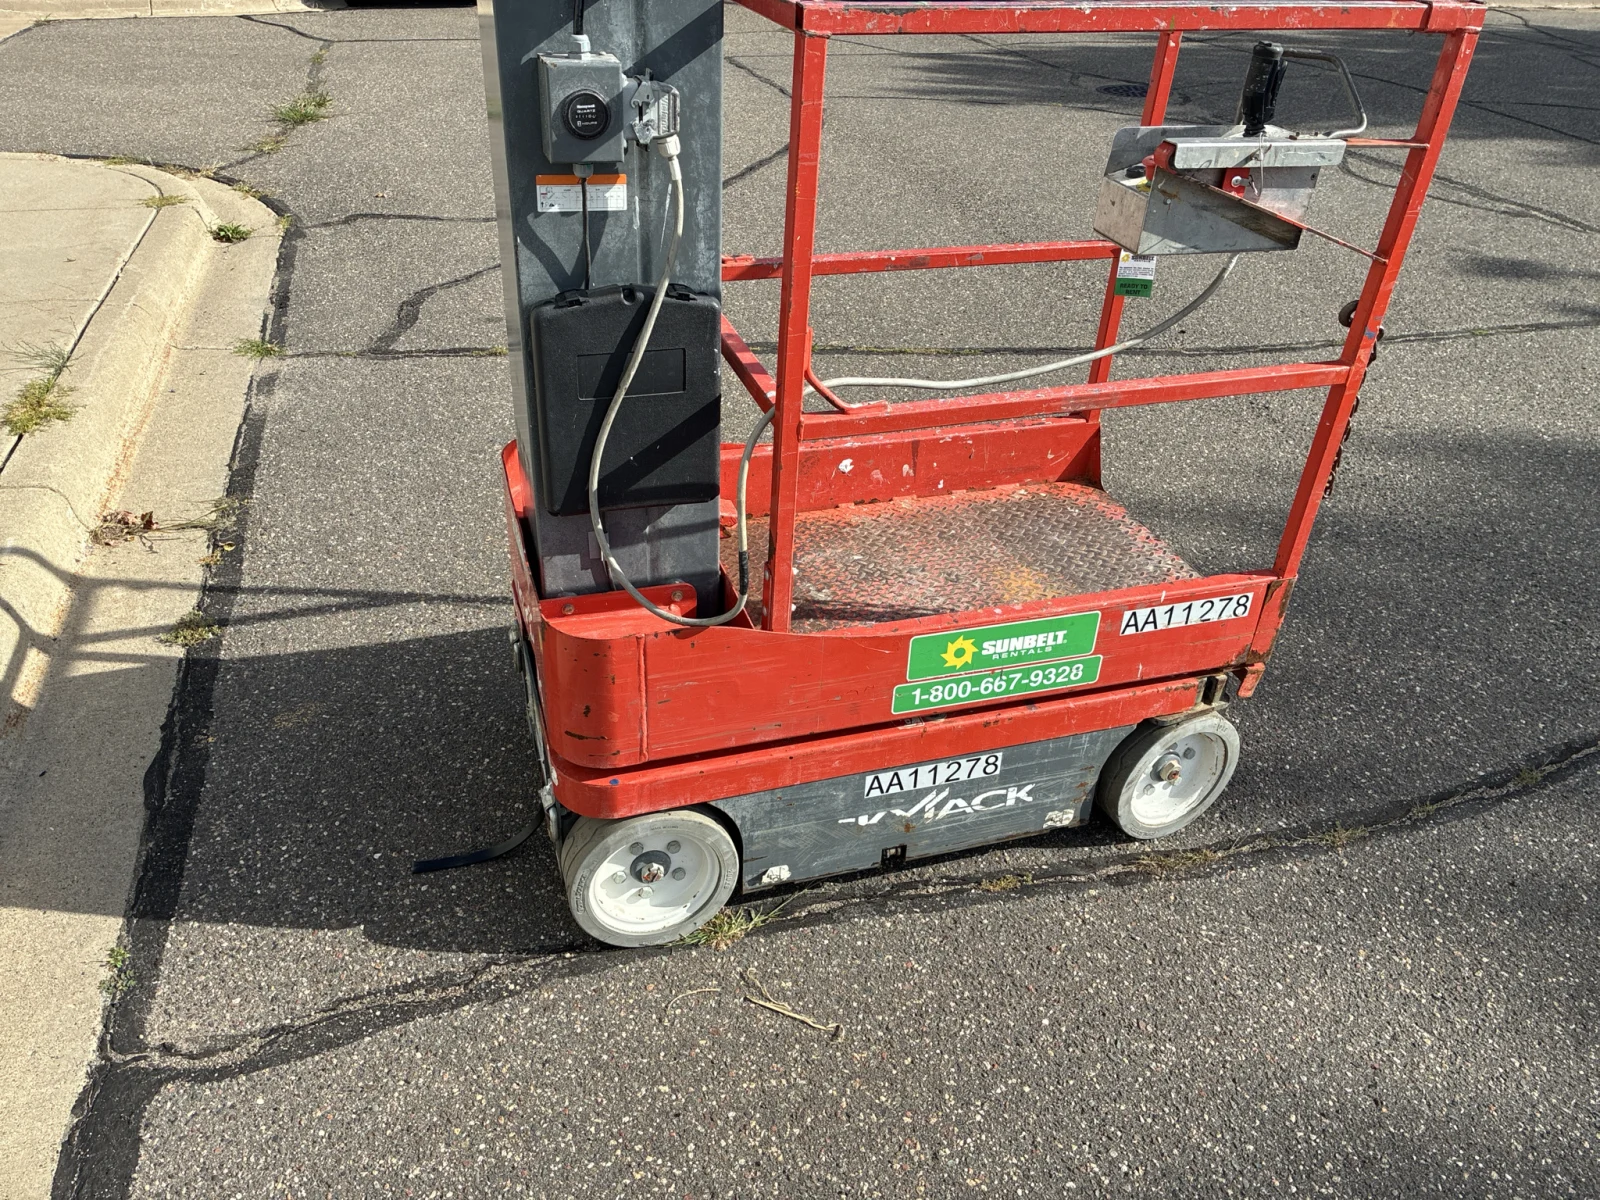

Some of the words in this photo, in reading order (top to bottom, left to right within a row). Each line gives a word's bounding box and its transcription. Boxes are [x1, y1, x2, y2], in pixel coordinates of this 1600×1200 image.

[1121, 594, 1250, 634] AA11278
[981, 630, 1067, 655] SUNBELT
[992, 646, 1052, 660] RENTALS
[911, 663, 1084, 705] 1-800-667-9328
[865, 754, 999, 797] AA11278
